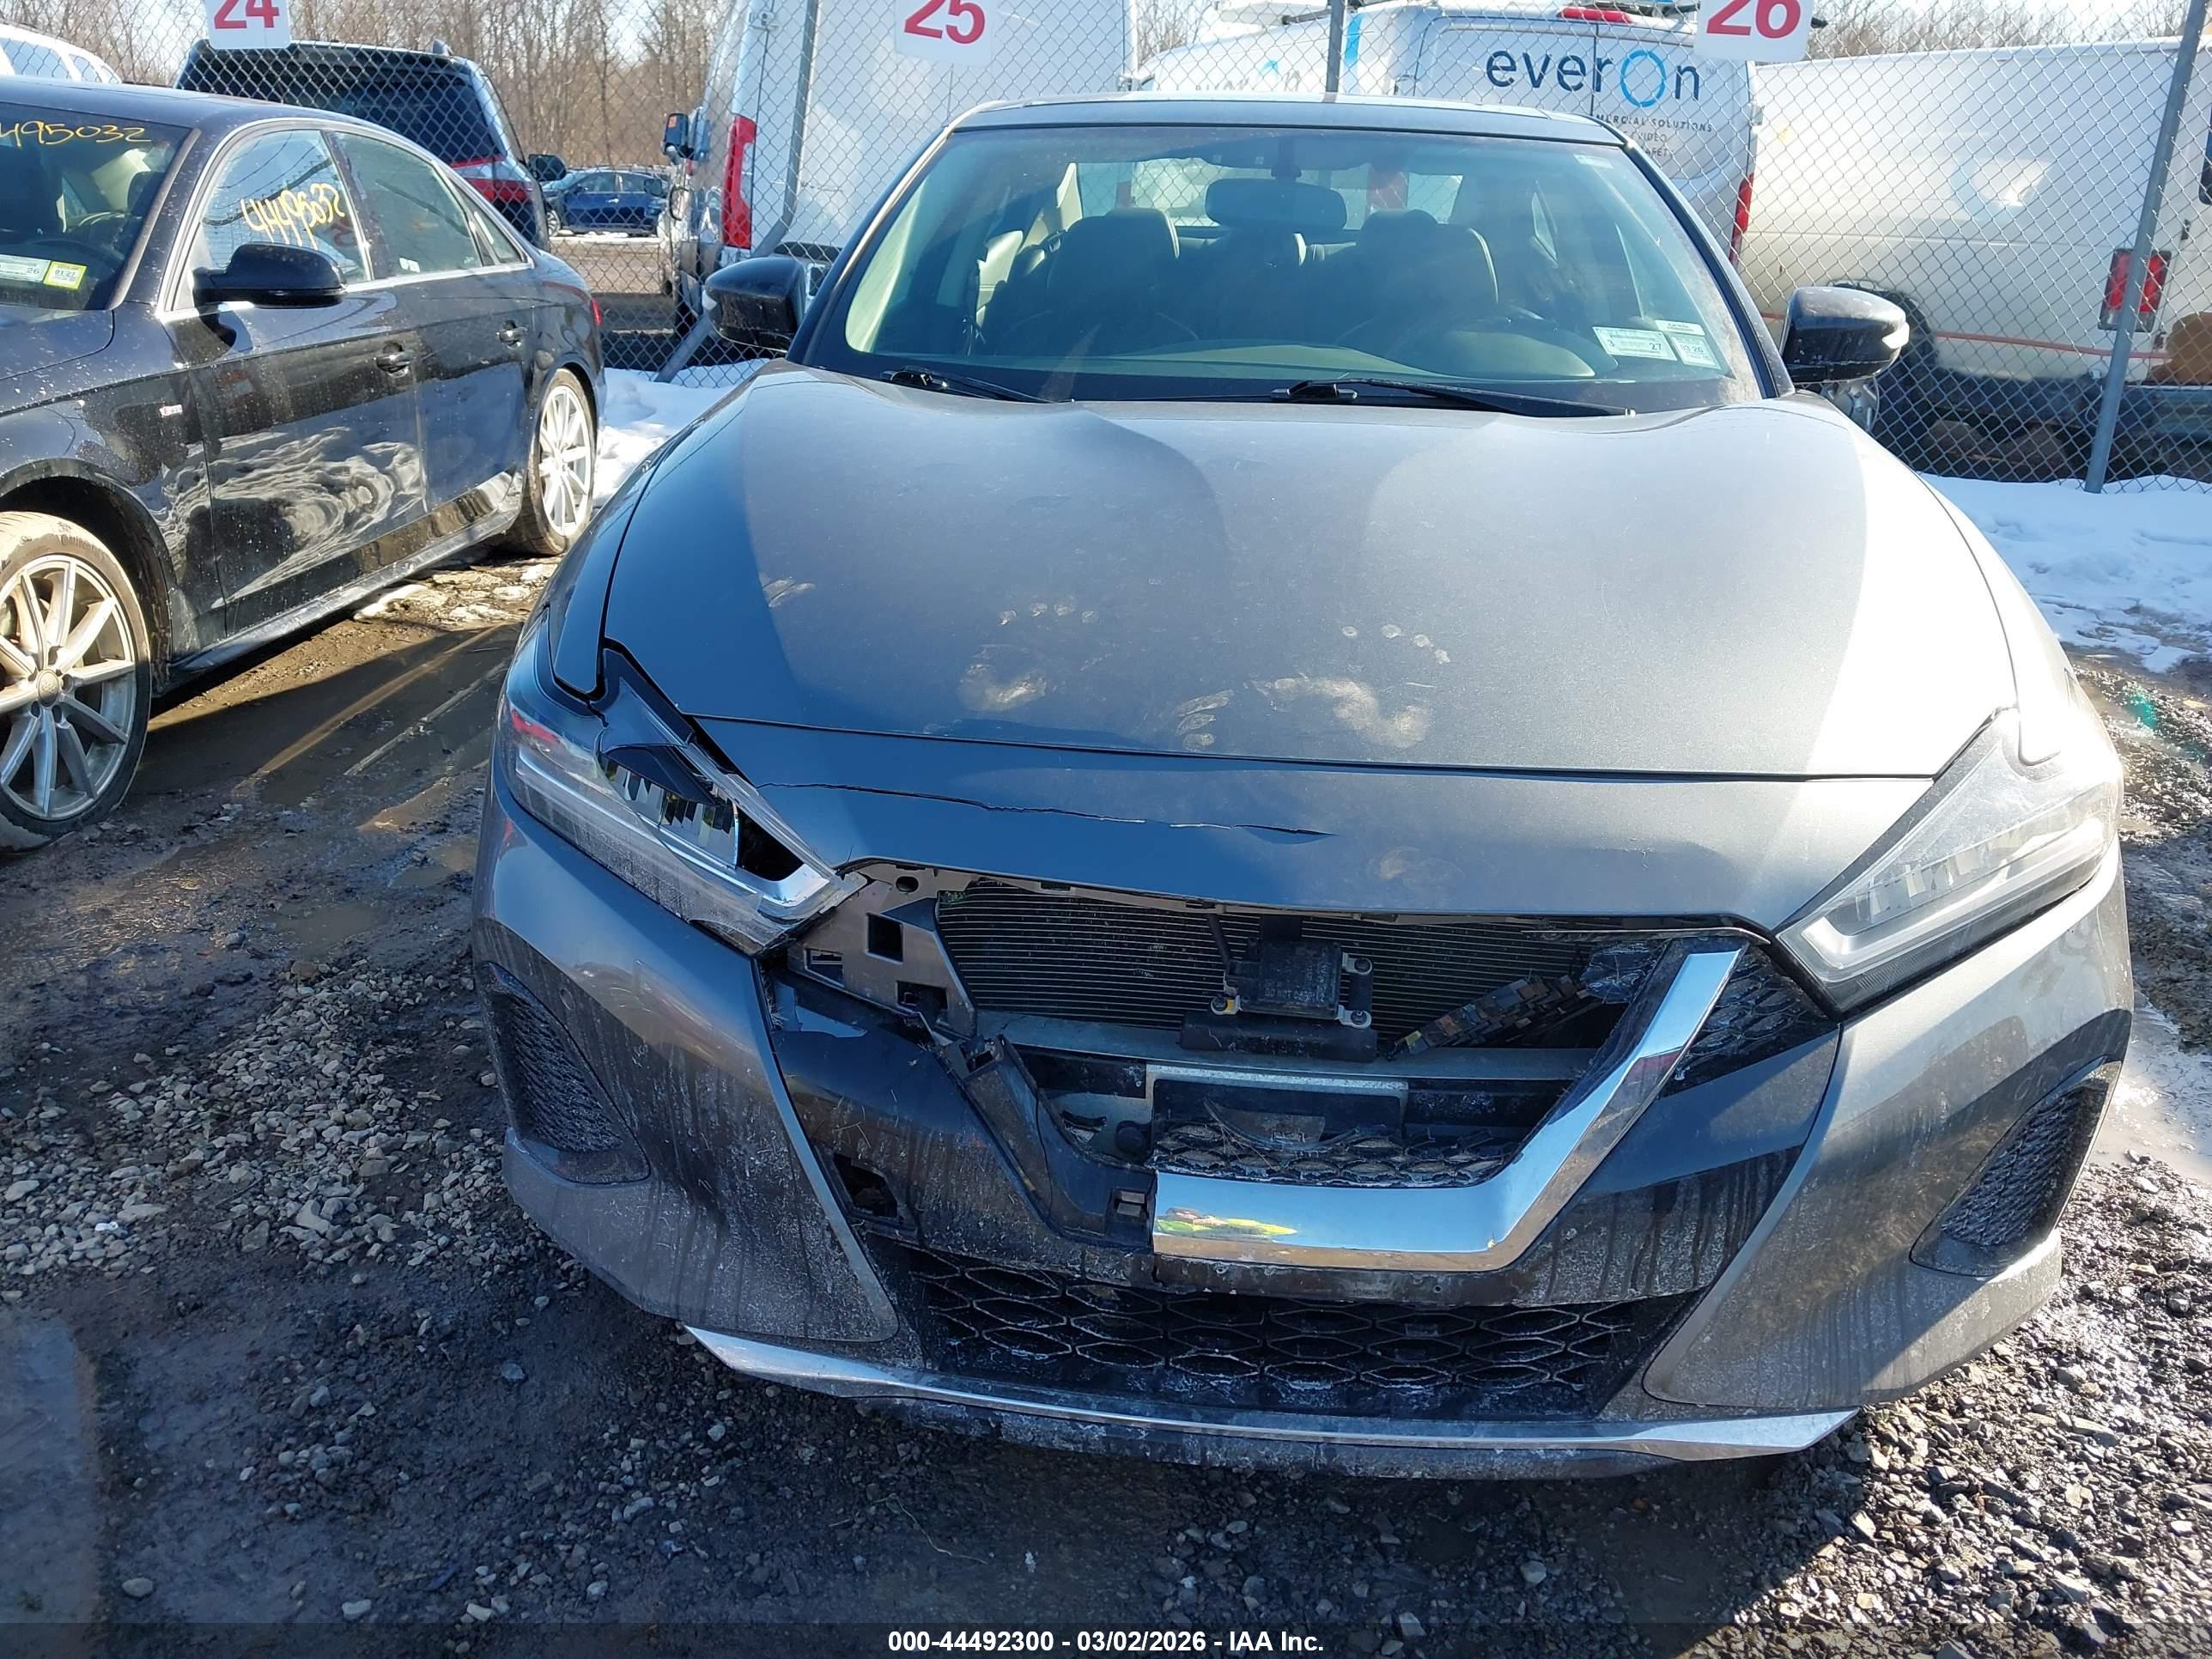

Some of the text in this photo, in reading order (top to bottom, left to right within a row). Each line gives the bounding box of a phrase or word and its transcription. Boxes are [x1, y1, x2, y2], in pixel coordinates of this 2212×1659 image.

[214, 0, 280, 29] 24
[904, 0, 985, 44] 25
[1706, 0, 1801, 39] 26
